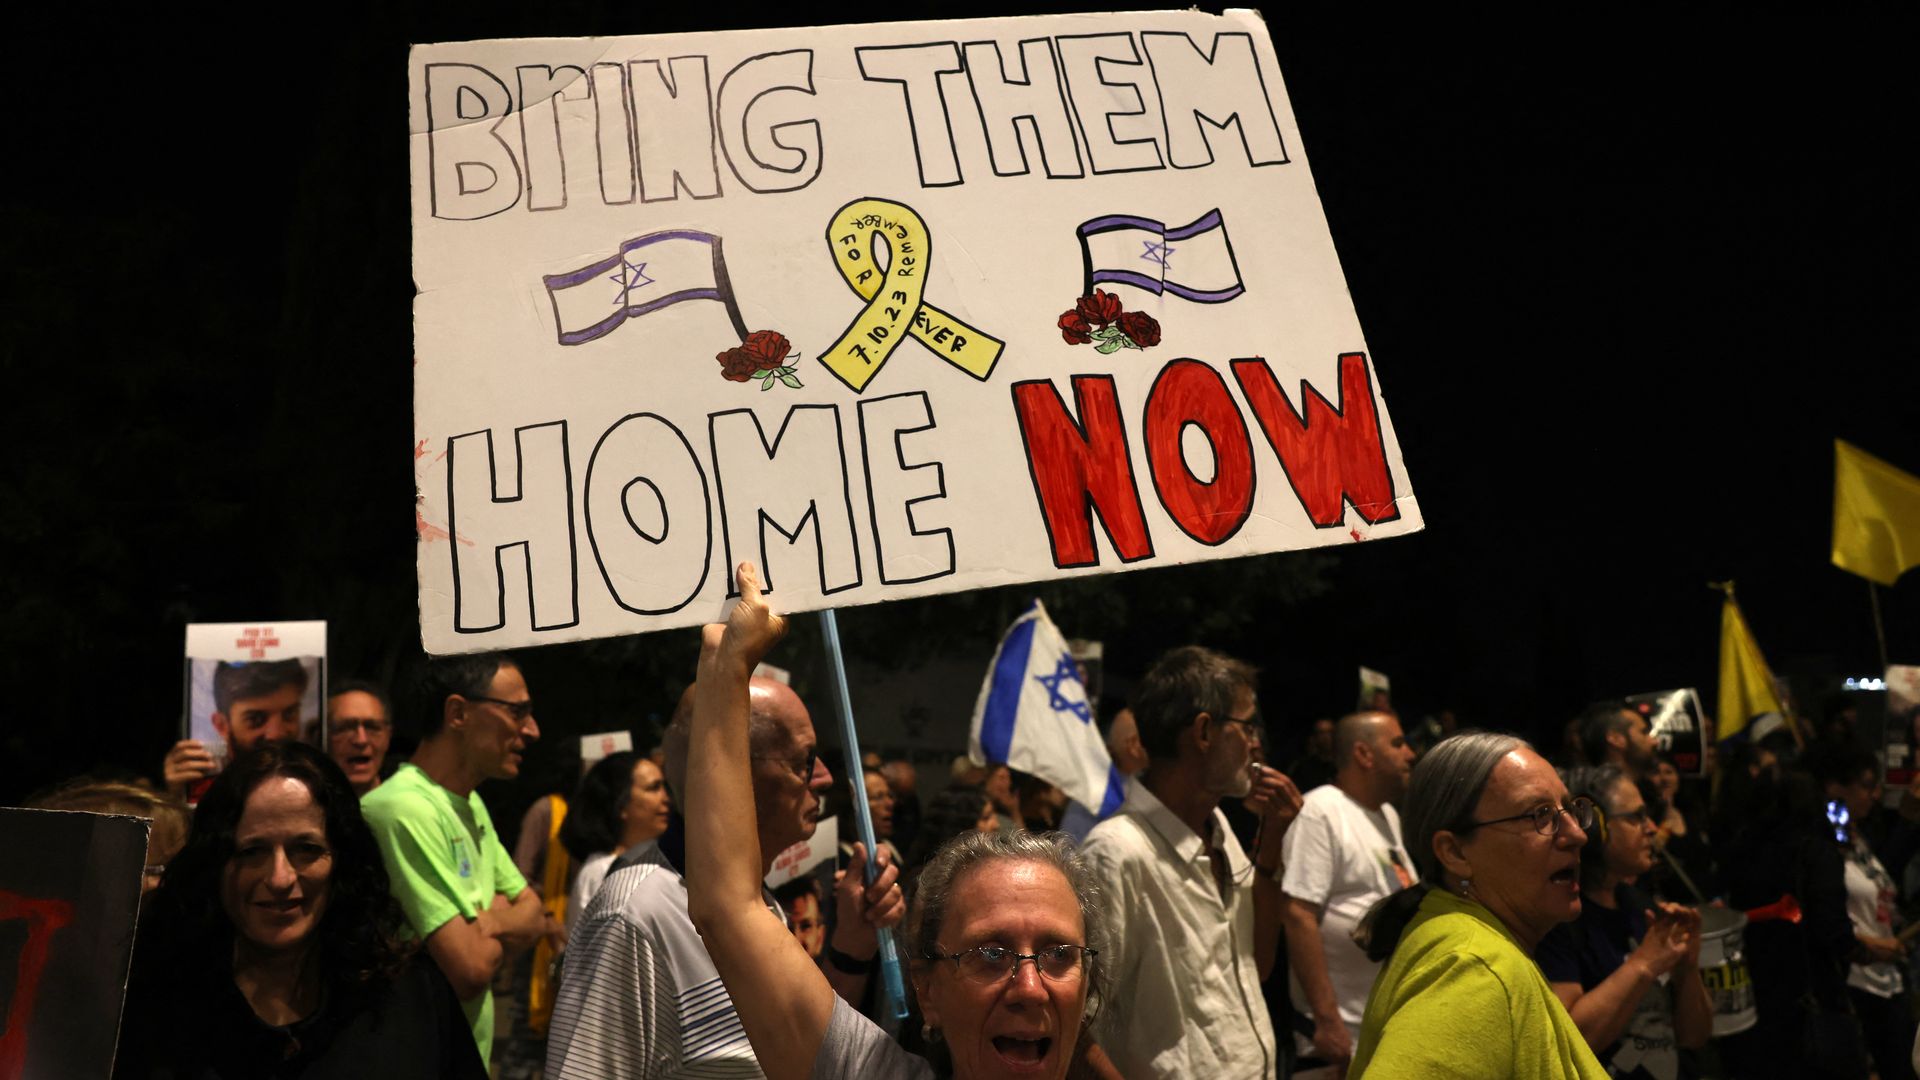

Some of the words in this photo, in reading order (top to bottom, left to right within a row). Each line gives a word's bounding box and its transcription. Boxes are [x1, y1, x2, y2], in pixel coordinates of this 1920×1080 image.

[855, 30, 1291, 188] THEM
[839, 233, 873, 286] FOR
[847, 290, 908, 366] 7.10.23
[914, 310, 968, 353] EVER
[446, 390, 956, 635] HOME
[1010, 352, 1400, 570] NOW
